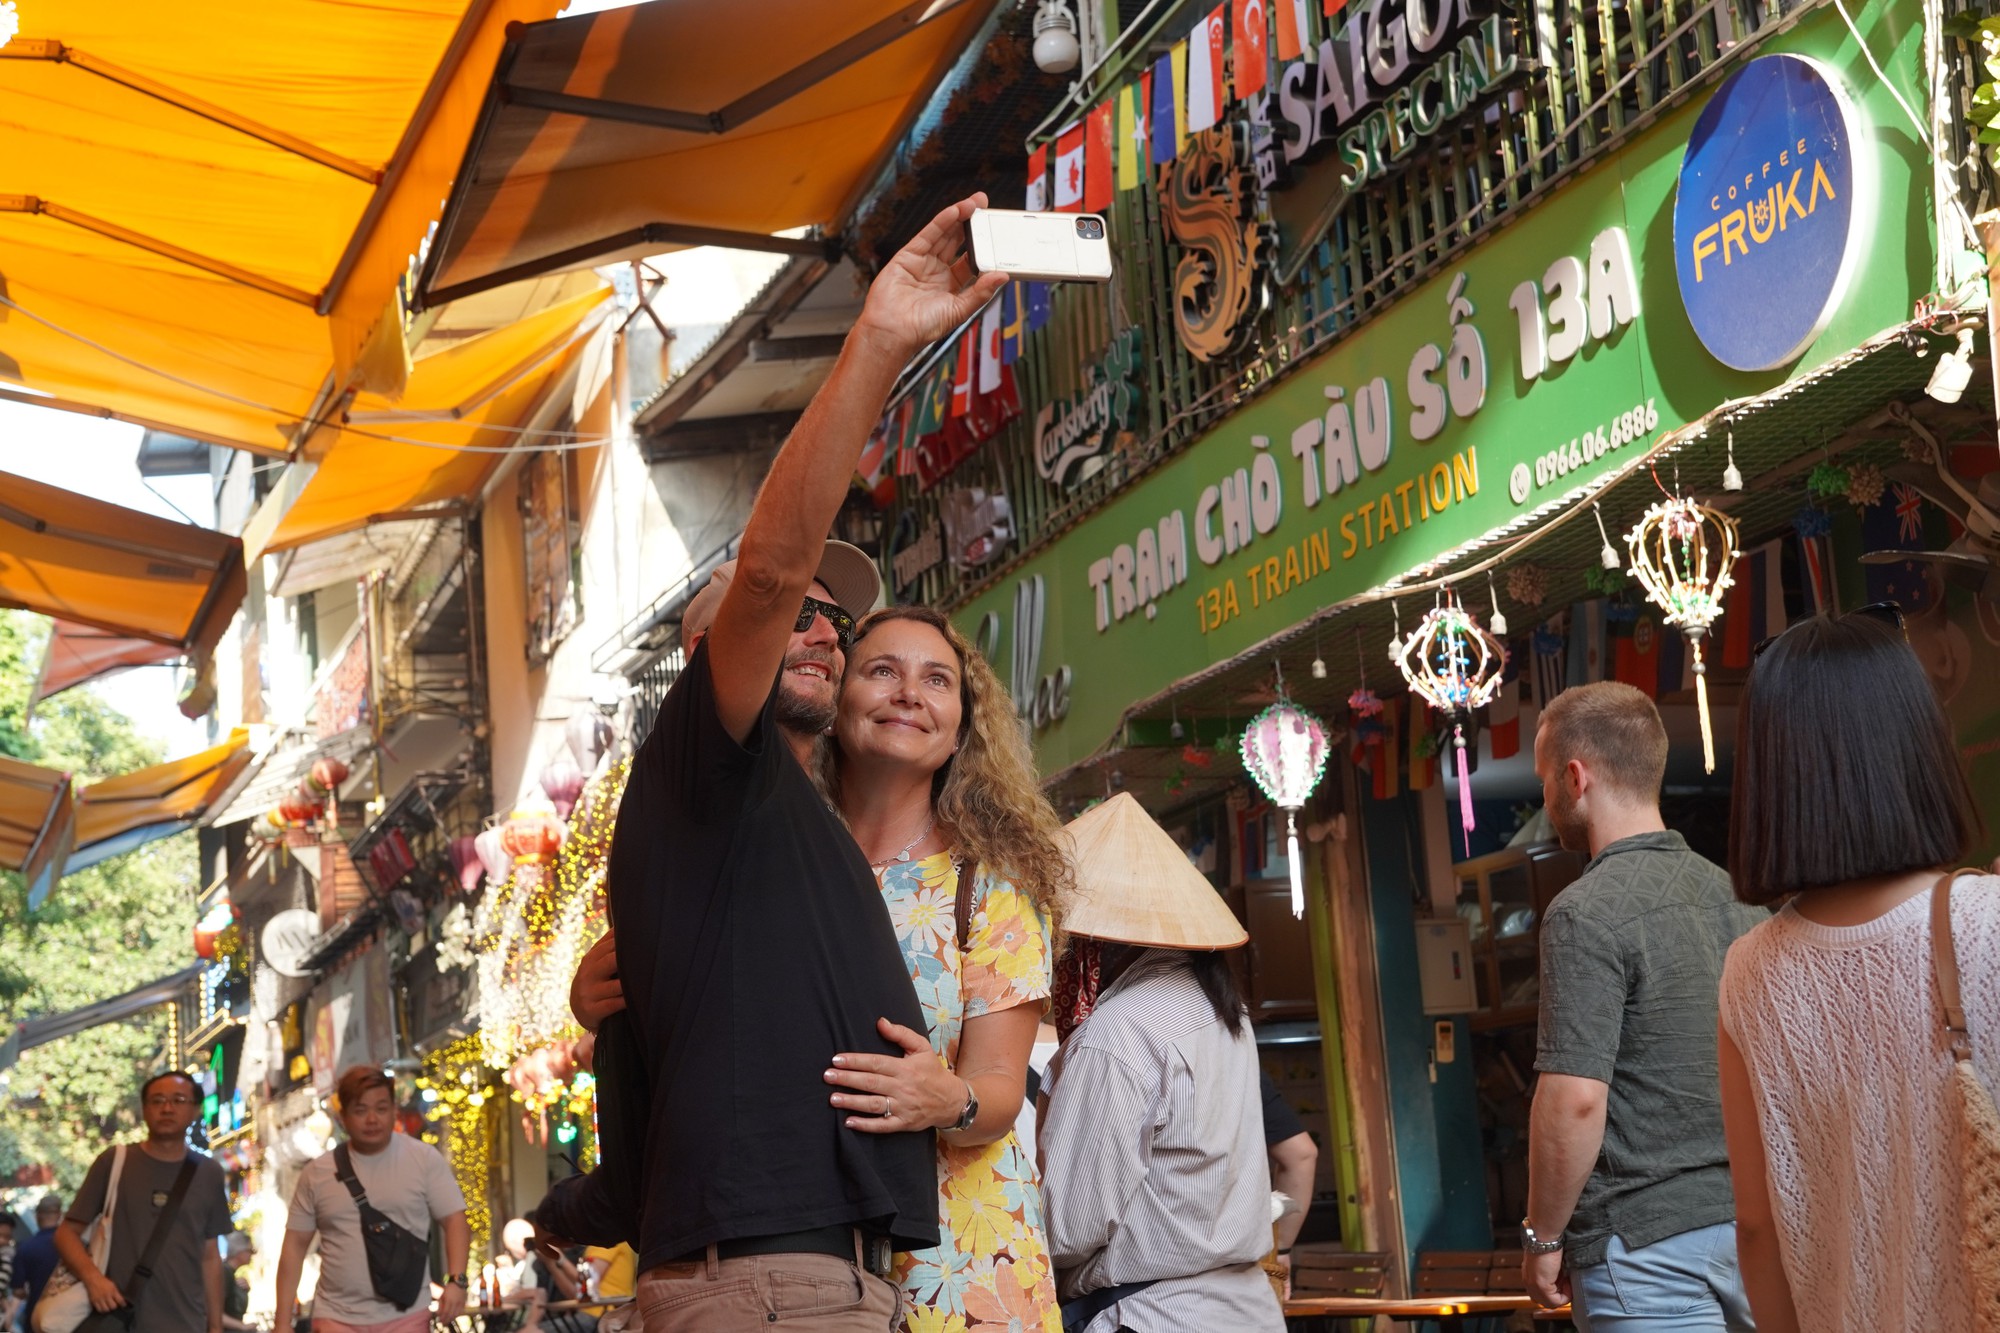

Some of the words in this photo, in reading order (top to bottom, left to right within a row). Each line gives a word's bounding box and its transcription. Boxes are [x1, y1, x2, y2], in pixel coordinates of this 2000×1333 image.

[1337, 13, 1517, 193] SPECIAL
[1693, 158, 1836, 283] FRUKA
[1711, 138, 1807, 211] COFFEE
[1035, 382, 1111, 480] Carlsberg
[1088, 509, 1187, 632] TRẠM
[1291, 376, 1391, 508] TÀU
[1407, 271, 1486, 441] SỐ
[1509, 226, 1641, 381] 13A
[1535, 398, 1659, 488] 0966.06.6886
[1195, 579, 1240, 634] 13A
[1247, 527, 1331, 609] TRAIN
[1340, 445, 1480, 560] STATION
